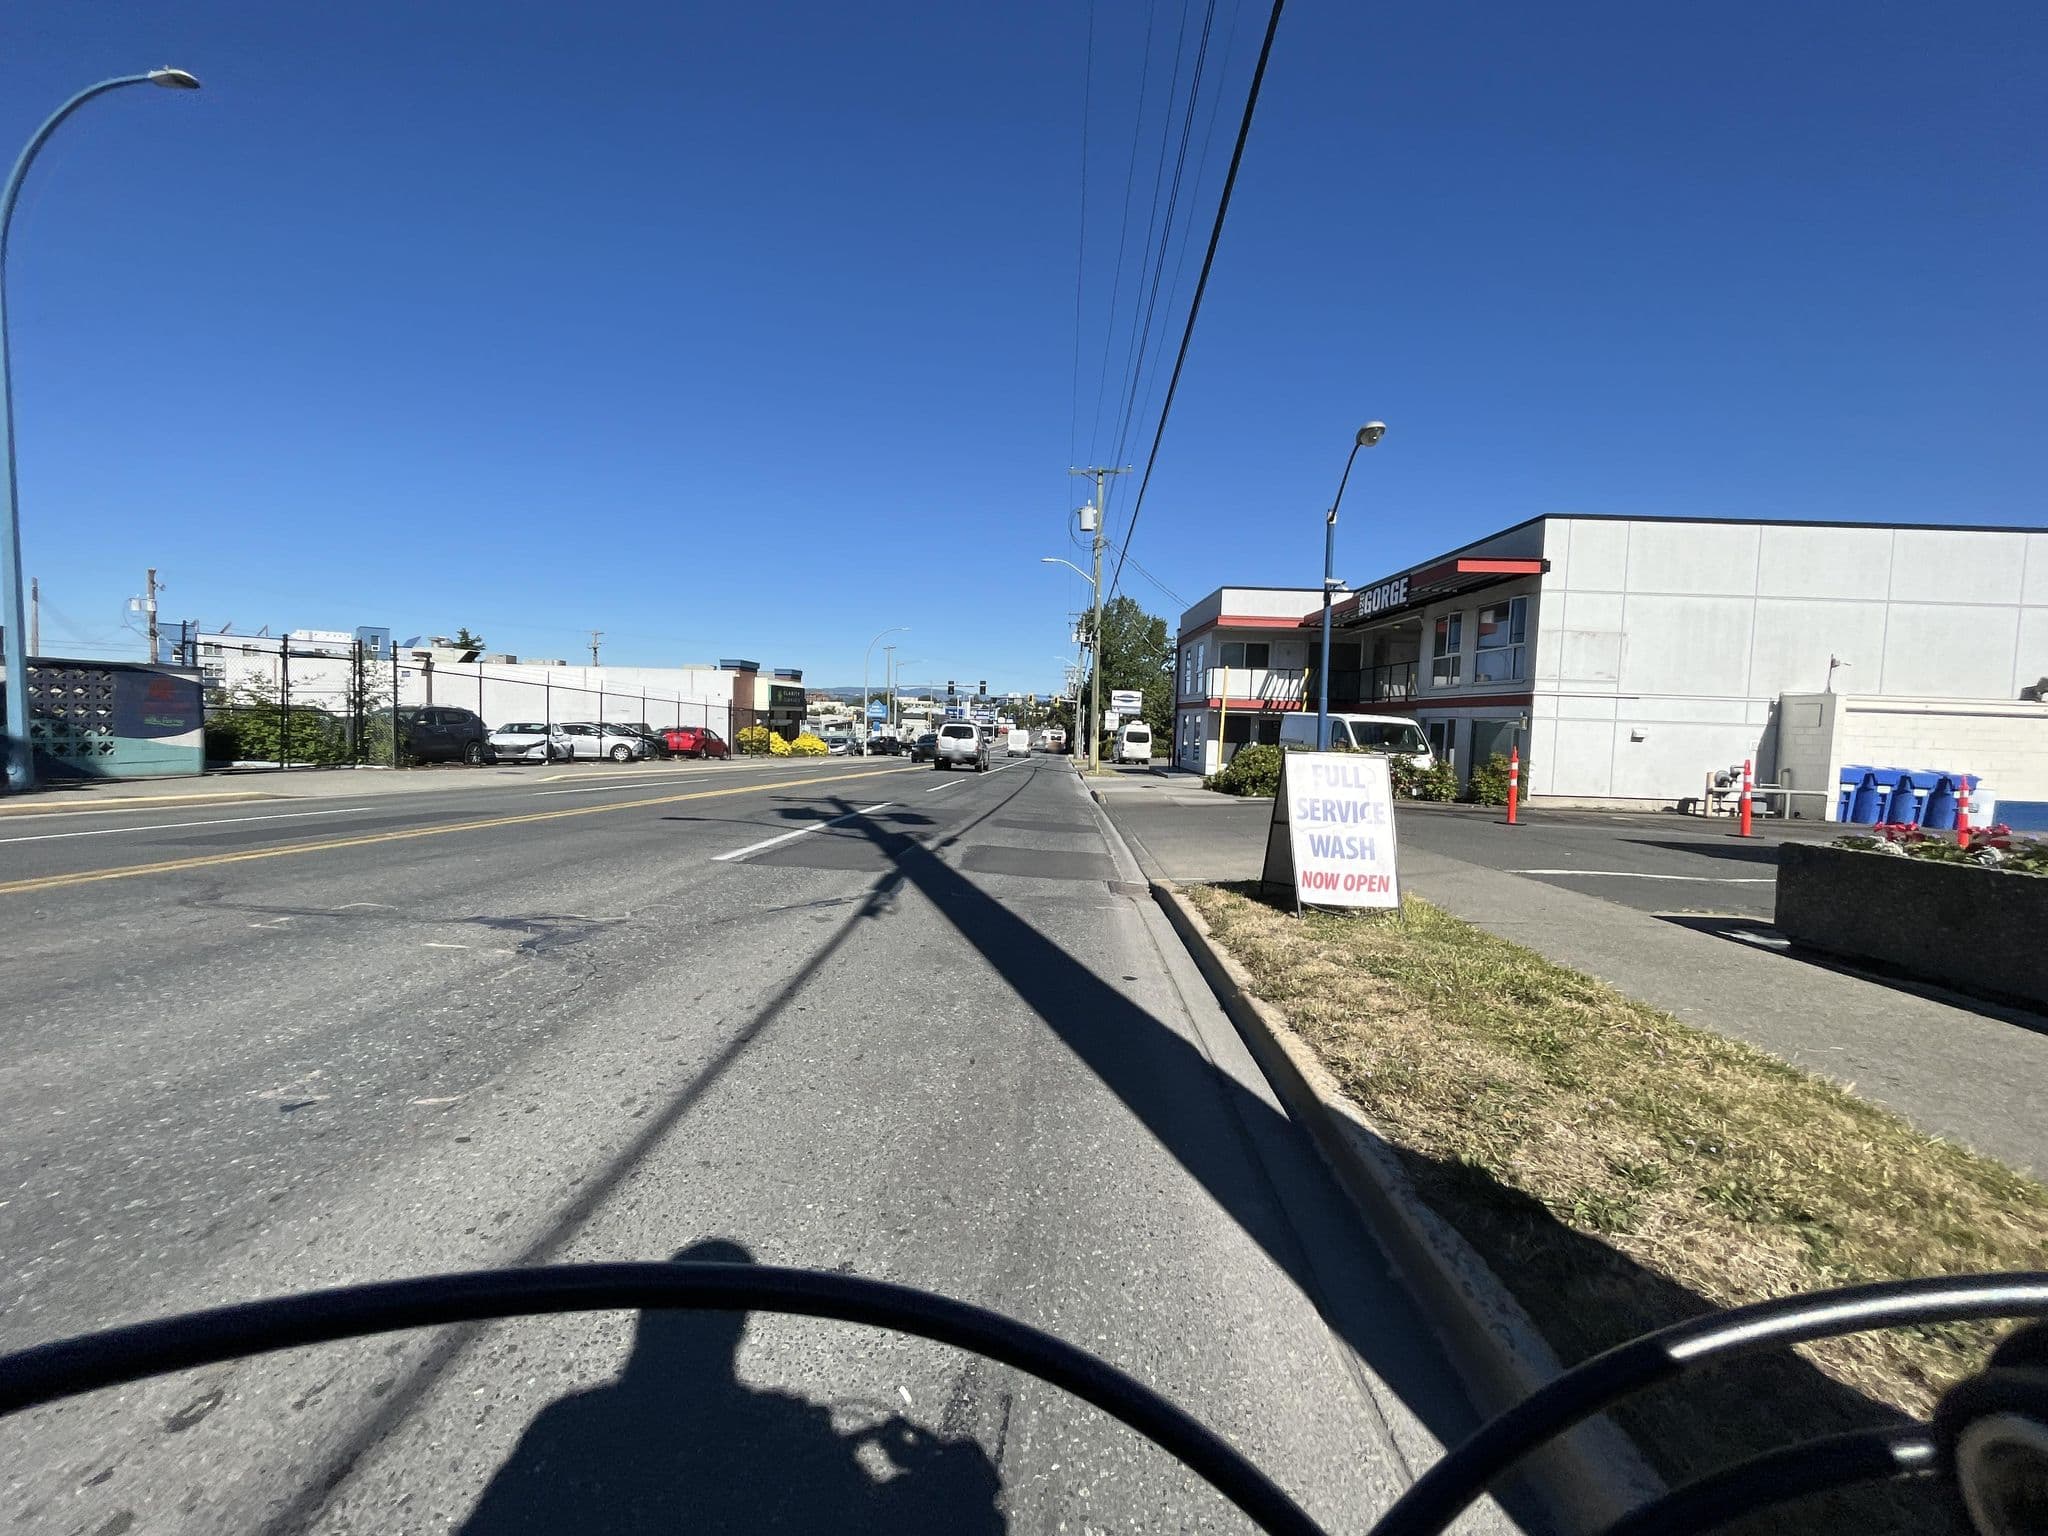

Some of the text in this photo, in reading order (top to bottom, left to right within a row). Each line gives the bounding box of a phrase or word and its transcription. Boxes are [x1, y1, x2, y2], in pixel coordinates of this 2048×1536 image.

[1364, 577, 1408, 614] GORGE
[1312, 764, 1366, 789] FULL
[1296, 798, 1386, 825] SERVICE
[1309, 834, 1376, 860] WASH
[1302, 870, 1390, 893] NOW OPEN
